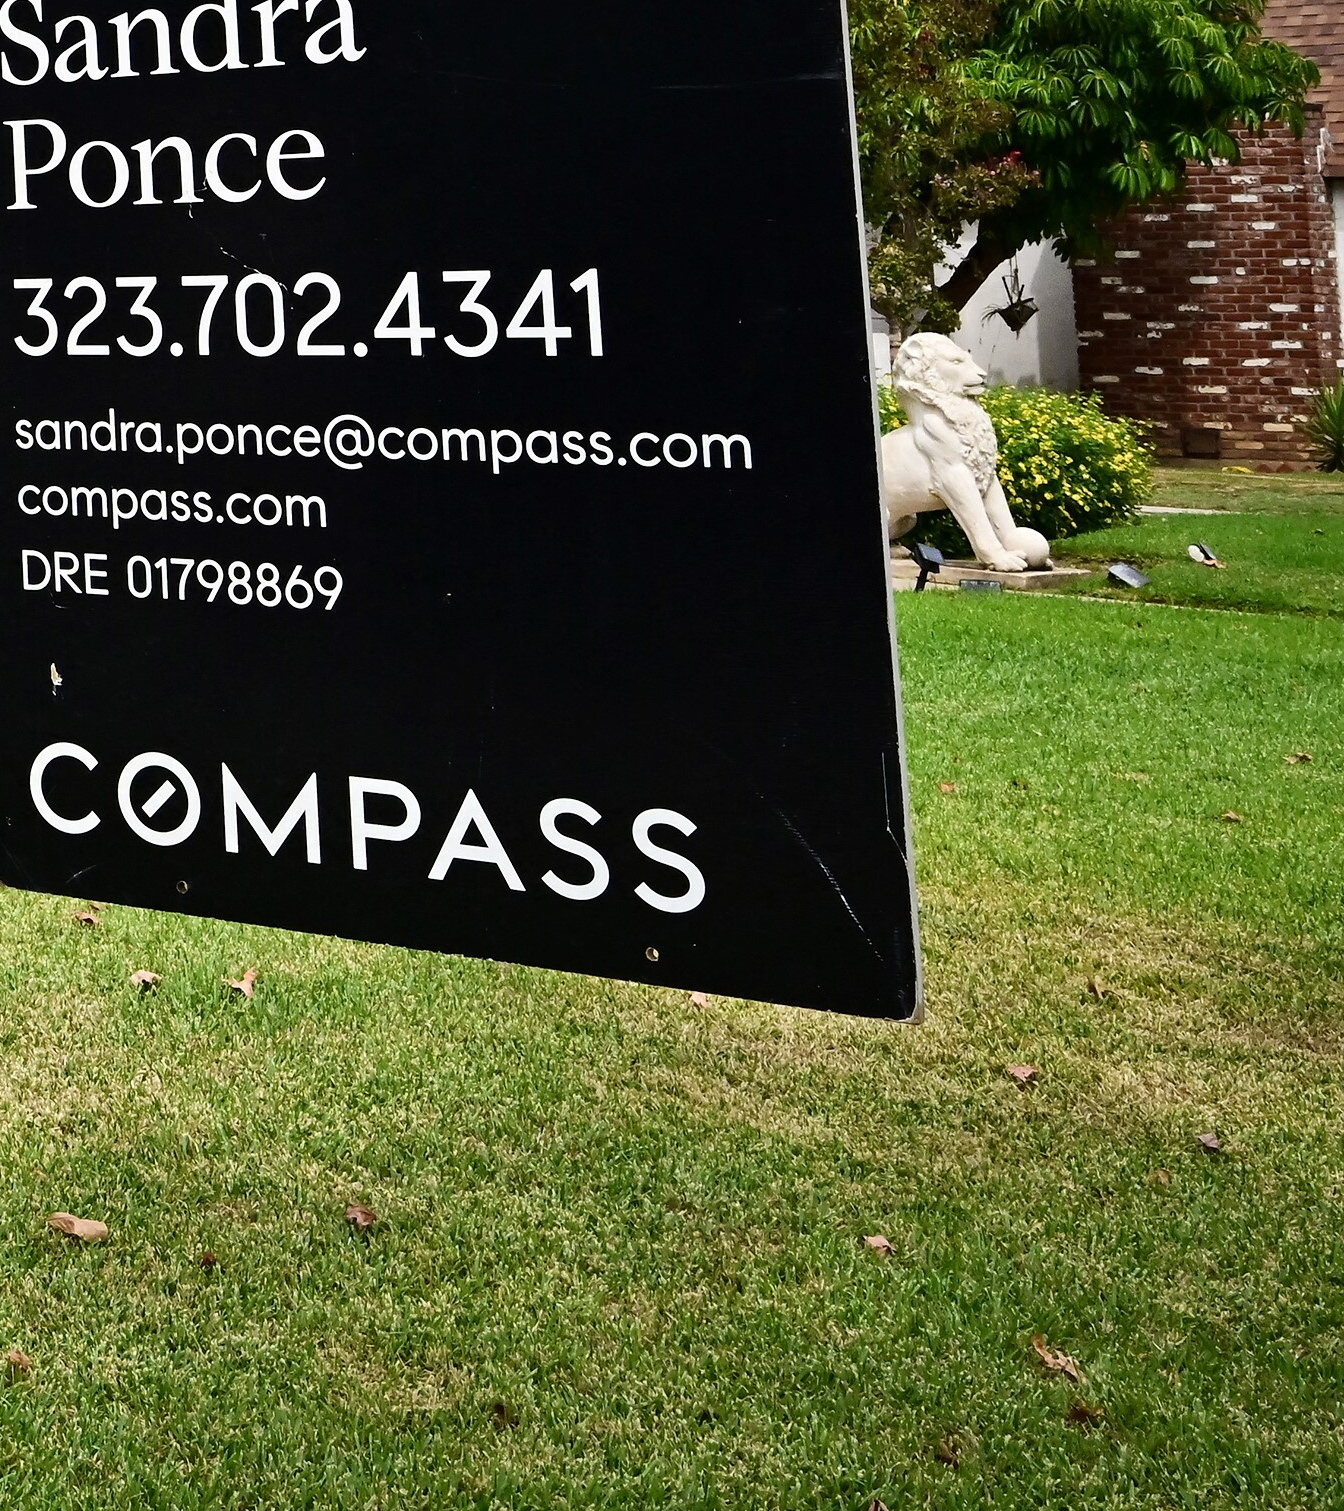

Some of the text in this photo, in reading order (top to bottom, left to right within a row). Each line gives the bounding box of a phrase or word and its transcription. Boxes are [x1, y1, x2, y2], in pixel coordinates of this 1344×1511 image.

[2, 118, 327, 210] Ponce
[13, 267, 604, 358] 323.702.4341
[15, 407, 753, 475] sandra.ponce@compass.com
[17, 484, 327, 530] compass.com
[21, 549, 344, 611] DRE 01798869
[29, 741, 706, 914] COMPASS
